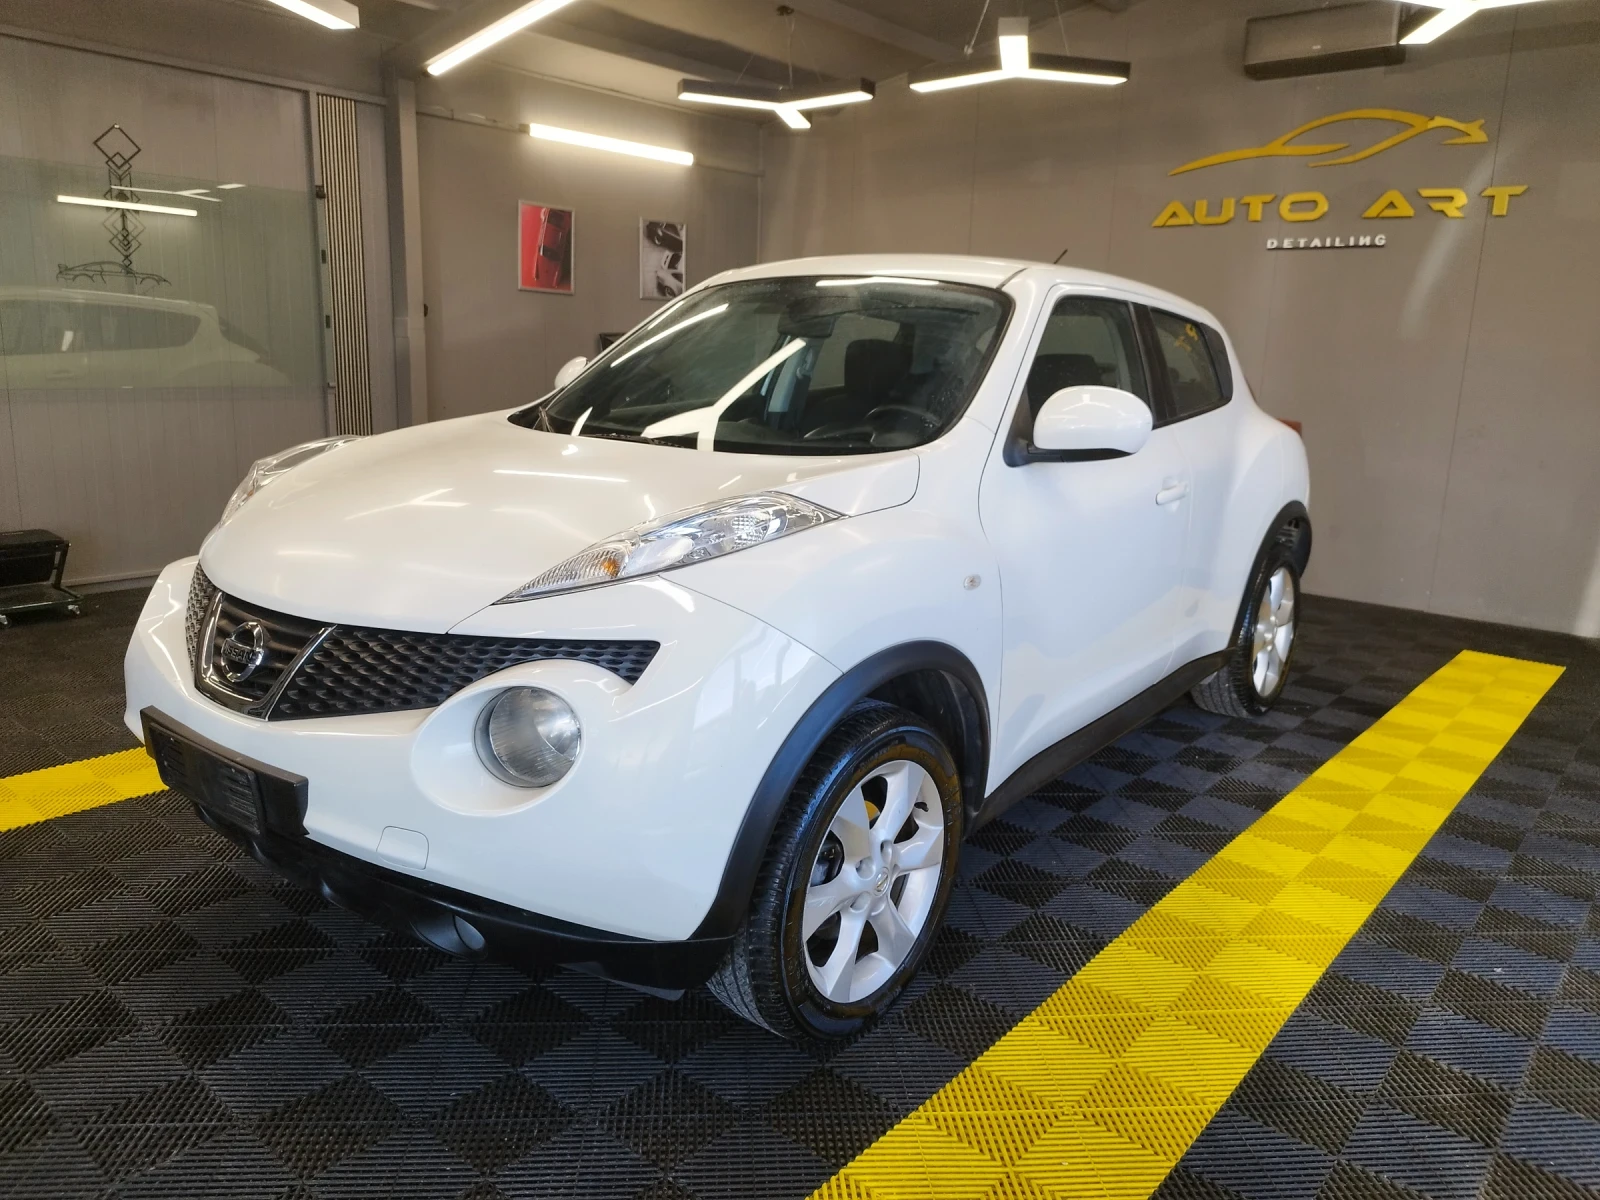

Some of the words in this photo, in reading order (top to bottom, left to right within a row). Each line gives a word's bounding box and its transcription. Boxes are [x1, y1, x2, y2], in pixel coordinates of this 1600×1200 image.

[1151, 191, 1329, 228] AUTO
[1361, 185, 1528, 219] ART
[1266, 234, 1387, 249] DETAILING
